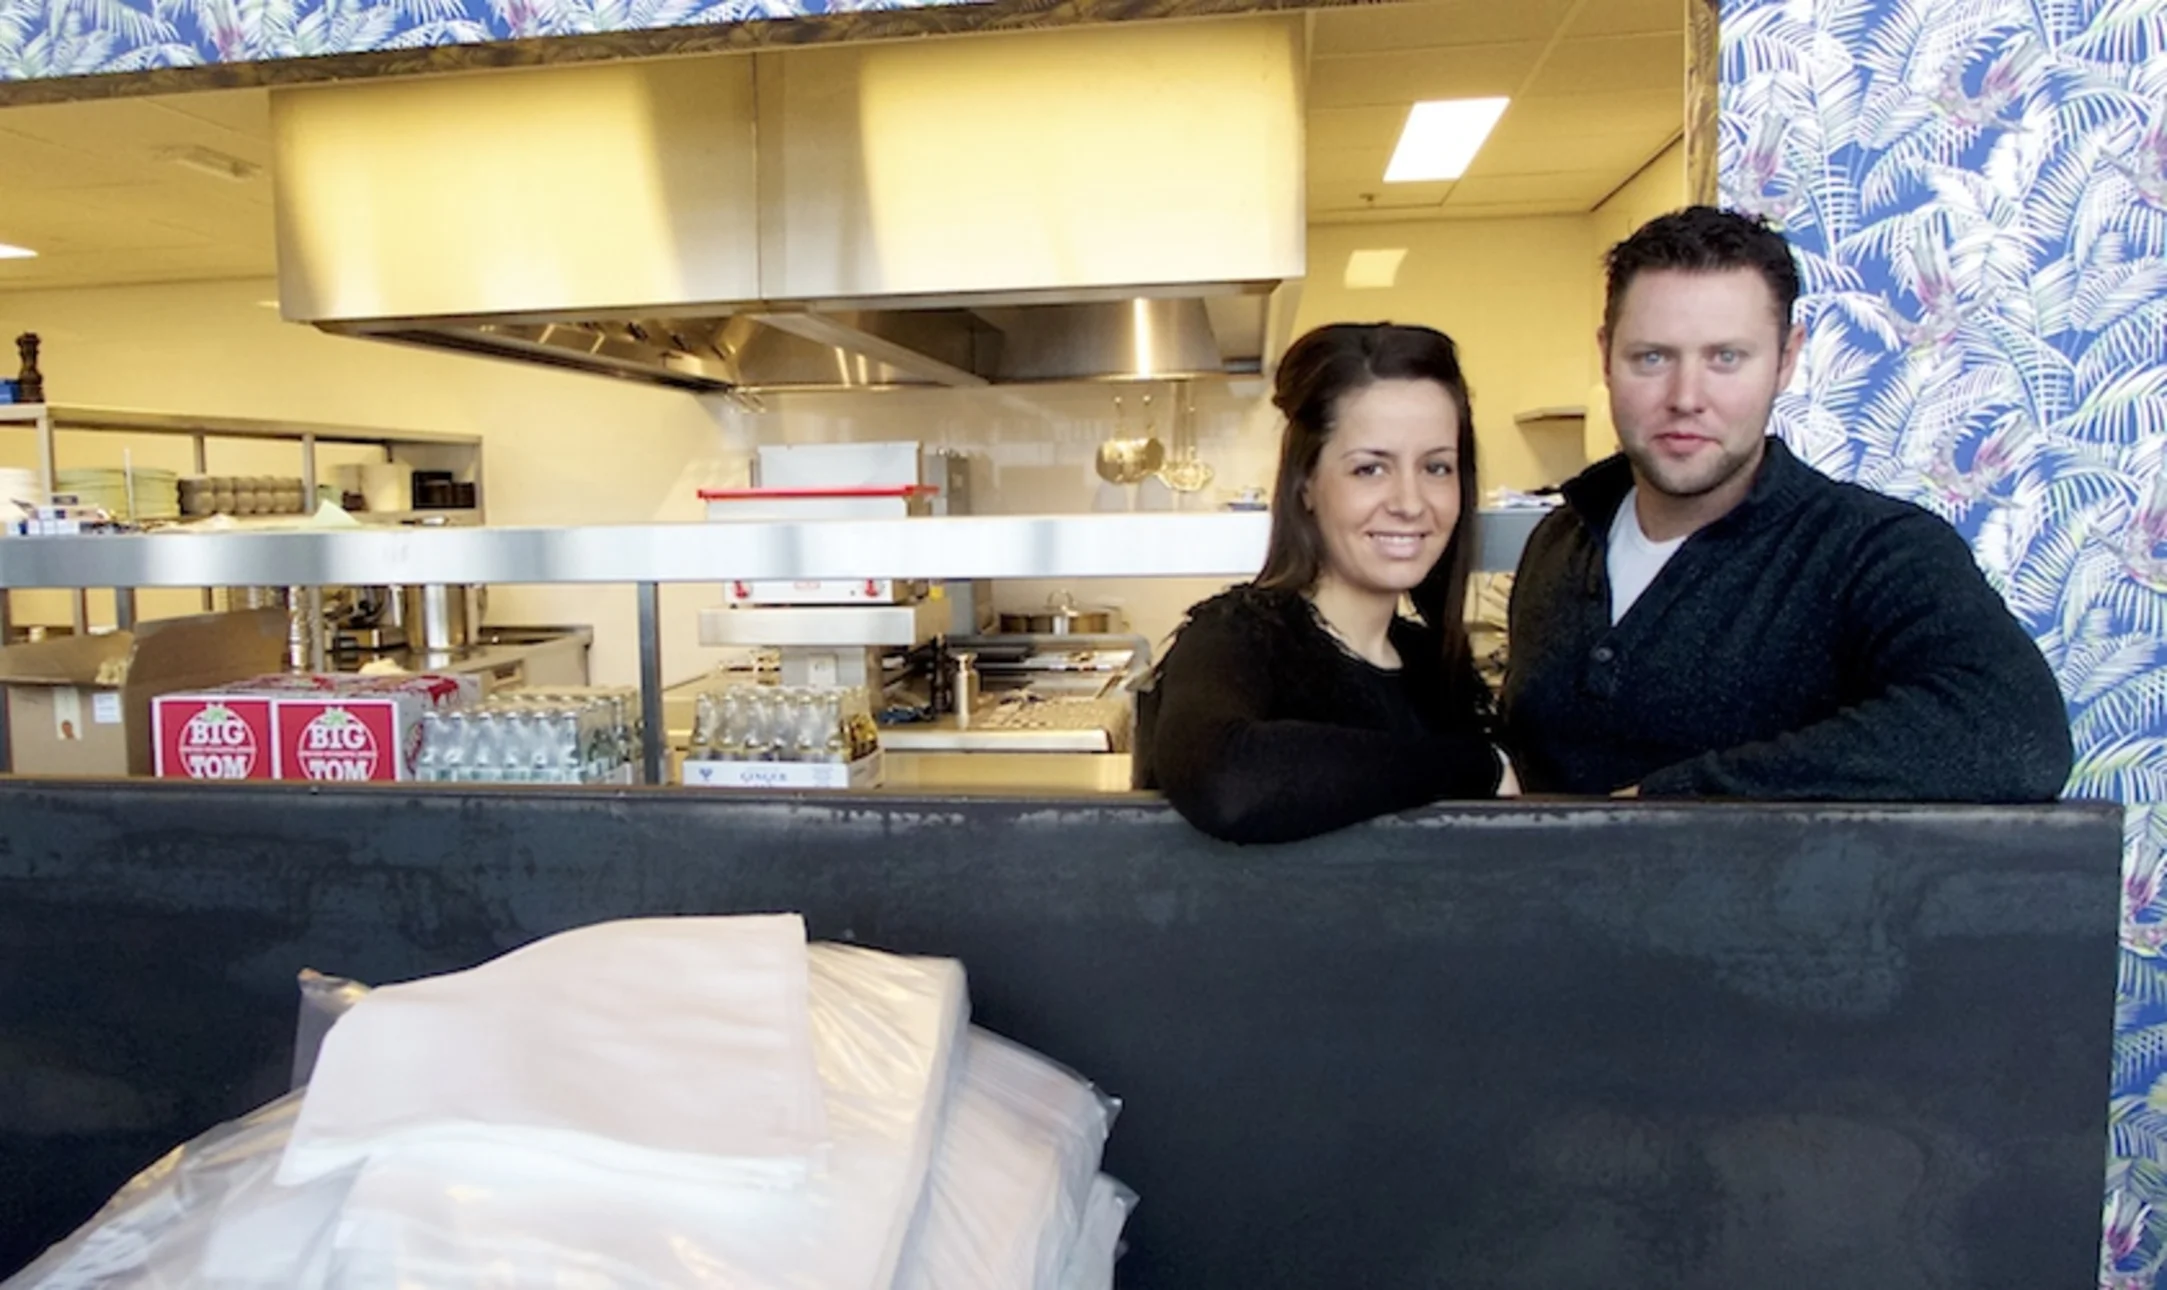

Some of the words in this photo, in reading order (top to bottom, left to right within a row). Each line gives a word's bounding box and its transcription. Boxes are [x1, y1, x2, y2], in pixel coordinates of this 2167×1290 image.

[189, 721, 246, 745] BIG
[309, 725, 367, 750] BIG
[188, 755, 248, 780] TOM
[308, 759, 370, 782] TOM
